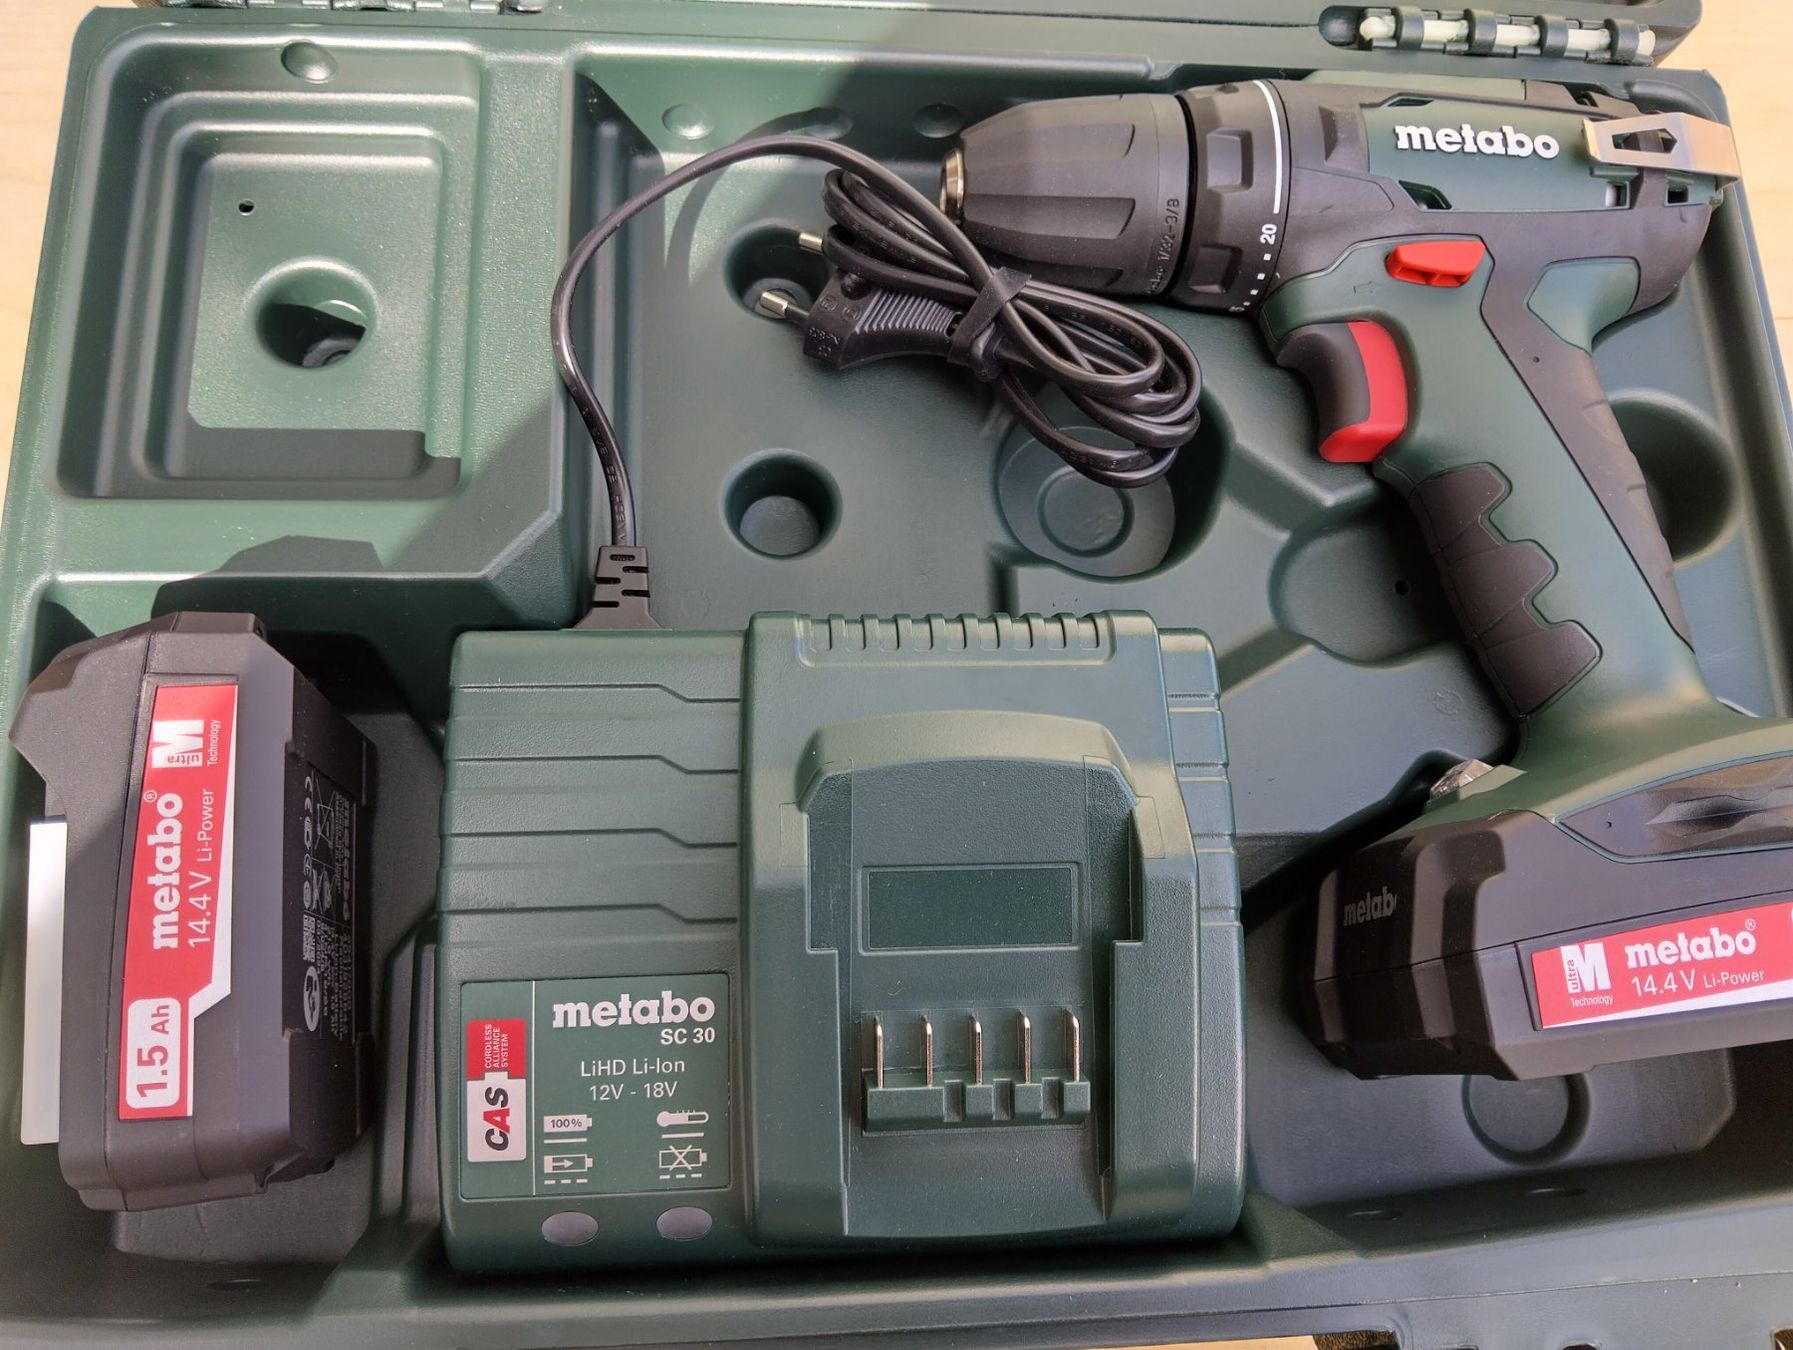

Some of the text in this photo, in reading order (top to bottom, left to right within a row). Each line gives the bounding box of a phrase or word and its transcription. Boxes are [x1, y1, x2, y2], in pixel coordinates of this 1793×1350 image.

[1395, 124, 1559, 159] metabo
[1259, 224, 1278, 245] 20
[207, 719, 221, 766] Technology
[148, 793, 183, 950] metabo
[188, 788, 215, 949] 14.4 V Li-Power
[1343, 886, 1397, 927] metab
[1626, 927, 1756, 969] metabo
[1631, 968, 1765, 997] 14.4 V Li-Power
[552, 990, 716, 1028] metabo
[1570, 995, 1613, 1008] Technology
[136, 1004, 170, 1099] 1.5 Ah
[484, 1024, 493, 1069] CORDLESS
[501, 1033, 509, 1068] SYSTEM
[660, 1027, 716, 1045] SC 30
[581, 1058, 685, 1077] LiHD Li-Ion
[590, 1084, 624, 1101] 12V
[644, 1081, 678, 1098] 18V
[483, 1086, 510, 1152] CAS
[550, 1118, 582, 1129] 100%
